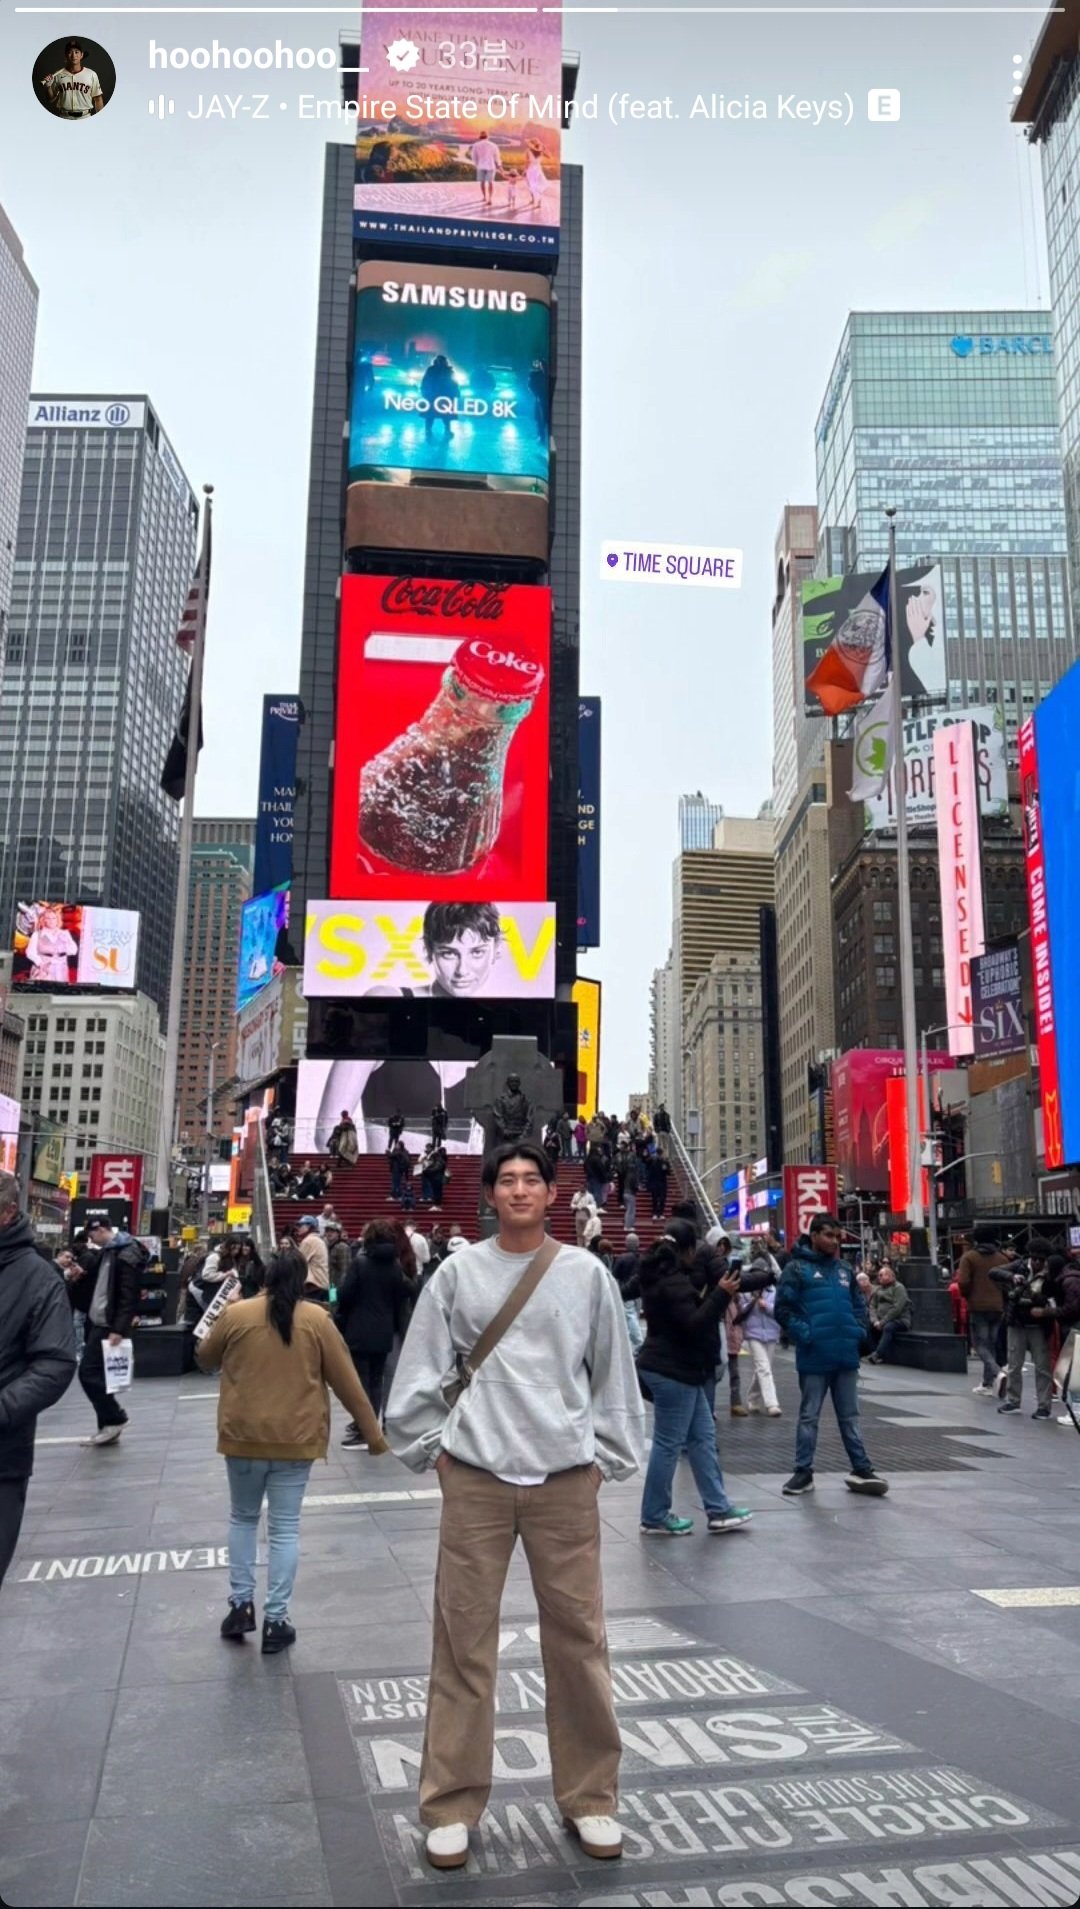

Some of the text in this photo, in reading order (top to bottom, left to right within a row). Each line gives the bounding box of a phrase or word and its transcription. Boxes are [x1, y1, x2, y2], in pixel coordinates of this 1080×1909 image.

[382, 281, 527, 312] SAMSUNG
[35, 406, 100, 422] Allianz
[384, 394, 516, 418] Neo QLED 8K
[469, 640, 538, 675] Coke
[577, 803, 595, 815] ND
[948, 740, 972, 988] LICENSED
[1030, 866, 1048, 938] COME
[1035, 942, 1054, 1036] INSIDE!
[103, 1159, 133, 1200] tkt
[510, 1657, 769, 1709] BROADAY
[788, 1707, 902, 1754] NEIL
[764, 1769, 976, 1808] IN THE SQUARE
[790, 1795, 1031, 1843] CIRCLE
